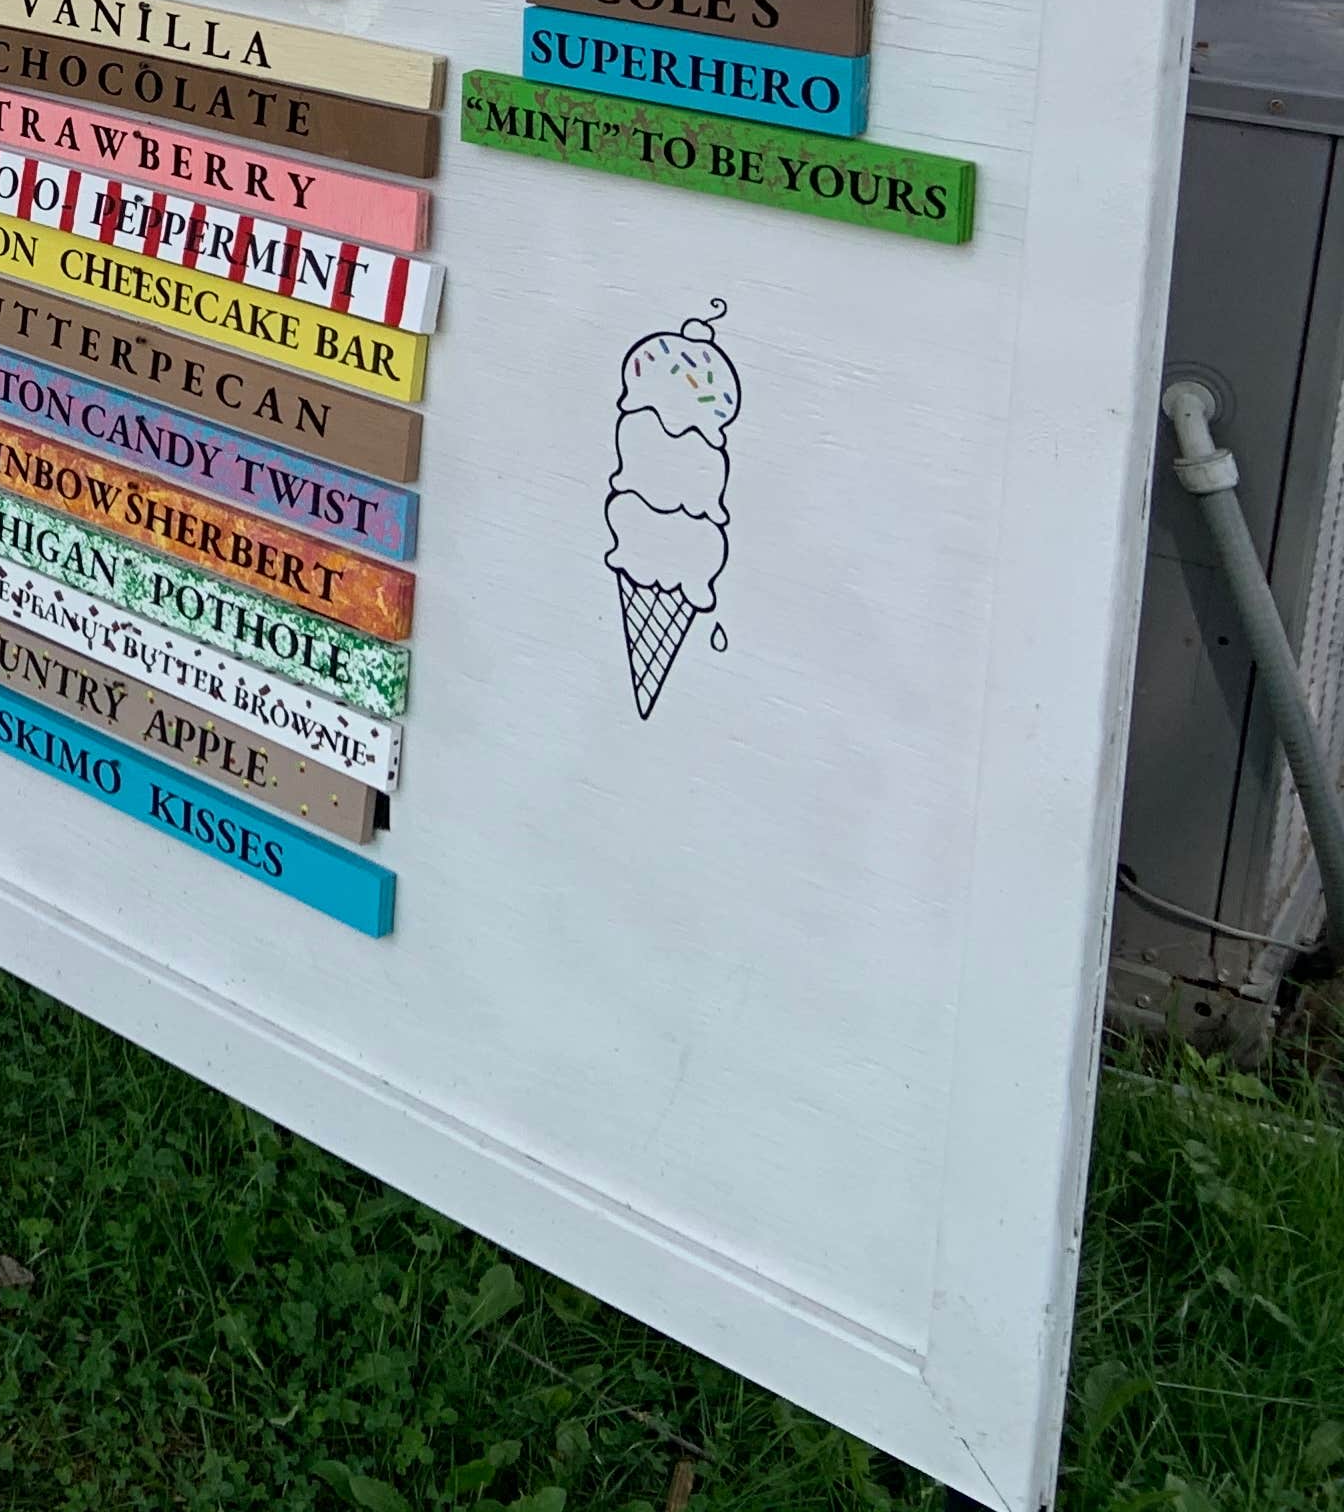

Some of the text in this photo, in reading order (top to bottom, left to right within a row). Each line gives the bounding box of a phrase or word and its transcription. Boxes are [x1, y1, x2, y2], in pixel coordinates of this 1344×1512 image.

[530, 29, 841, 115] SUPERHERO
[633, 129, 696, 170] TO
[709, 143, 764, 185] BE
[778, 156, 947, 221] YOURS
[90, 192, 370, 298] PEPPERMINT
[60, 249, 300, 350] CHEESECAKE
[314, 323, 401, 382] BAR
[81, 404, 225, 479] CANDY
[234, 455, 380, 536] TWIST
[125, 492, 345, 604] SHERBERT
[18, 587, 115, 653] PEANUT
[123, 636, 226, 703] BUTTER
[234, 685, 369, 766] BROWNIE
[153, 573, 354, 684] POTHOLE
[144, 709, 271, 788] APPLE
[150, 783, 285, 879] KISSES
